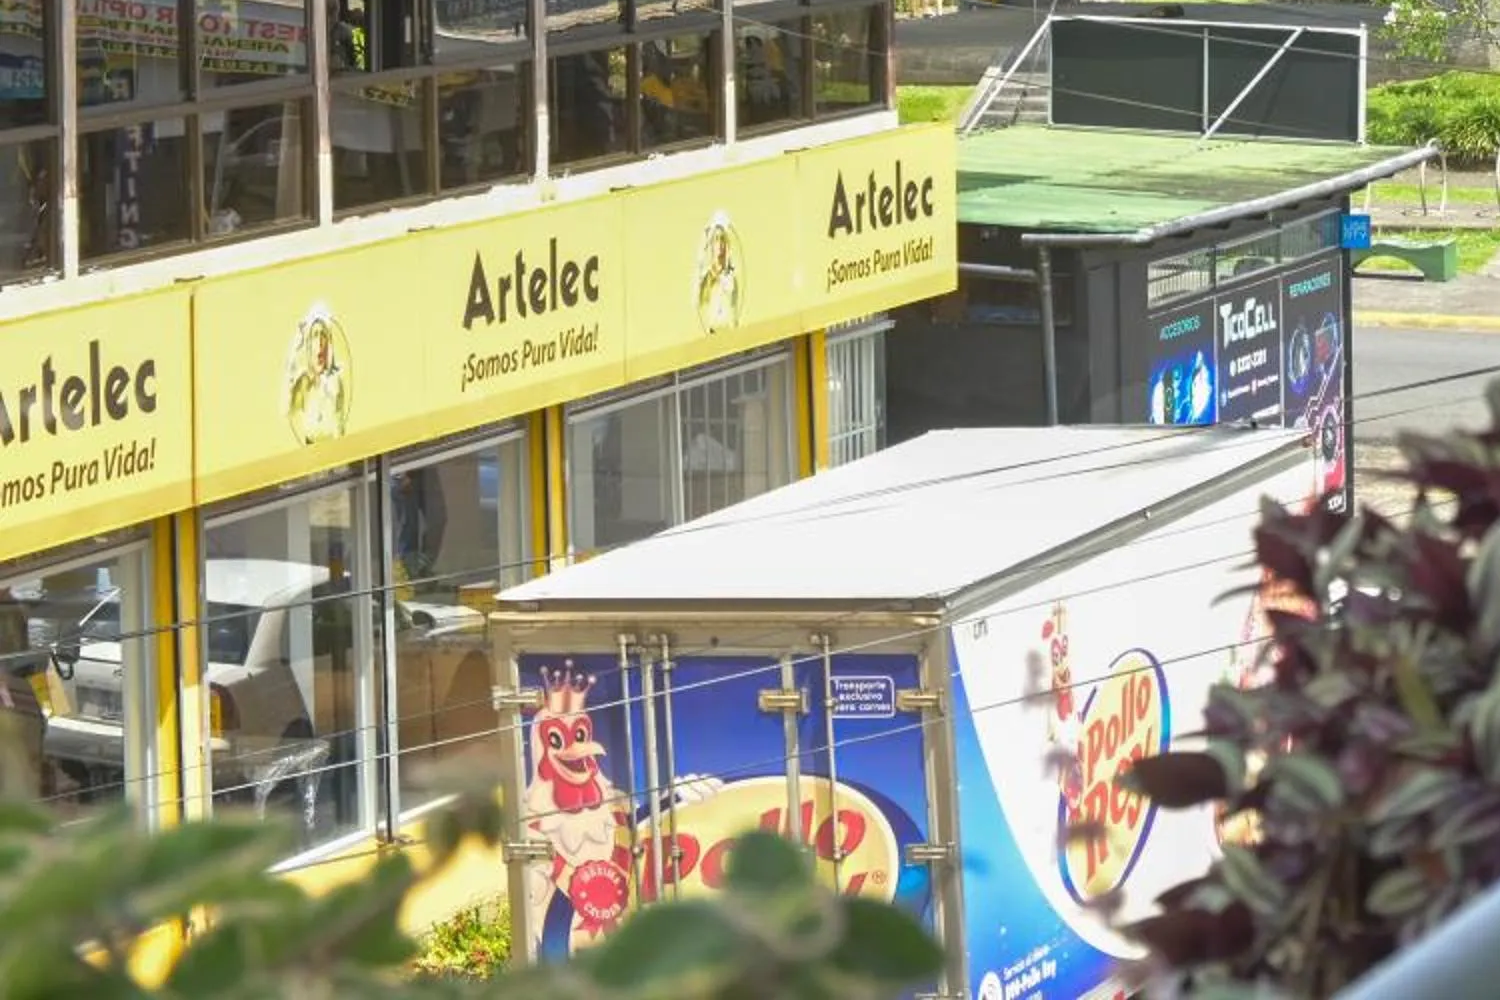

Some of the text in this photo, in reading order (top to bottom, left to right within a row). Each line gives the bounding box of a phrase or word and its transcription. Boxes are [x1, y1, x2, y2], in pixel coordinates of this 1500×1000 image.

[827, 159, 933, 240] Artelec
[462, 236, 599, 331] Artelec
[826, 235, 934, 294] ¡Somos Pura Vida!
[461, 322, 600, 393] ¡Somos Pura Vida!
[51, 459, 100, 495] Pura
[104, 436, 157, 482] Vida!
[1087, 672, 1152, 786] Pollo
